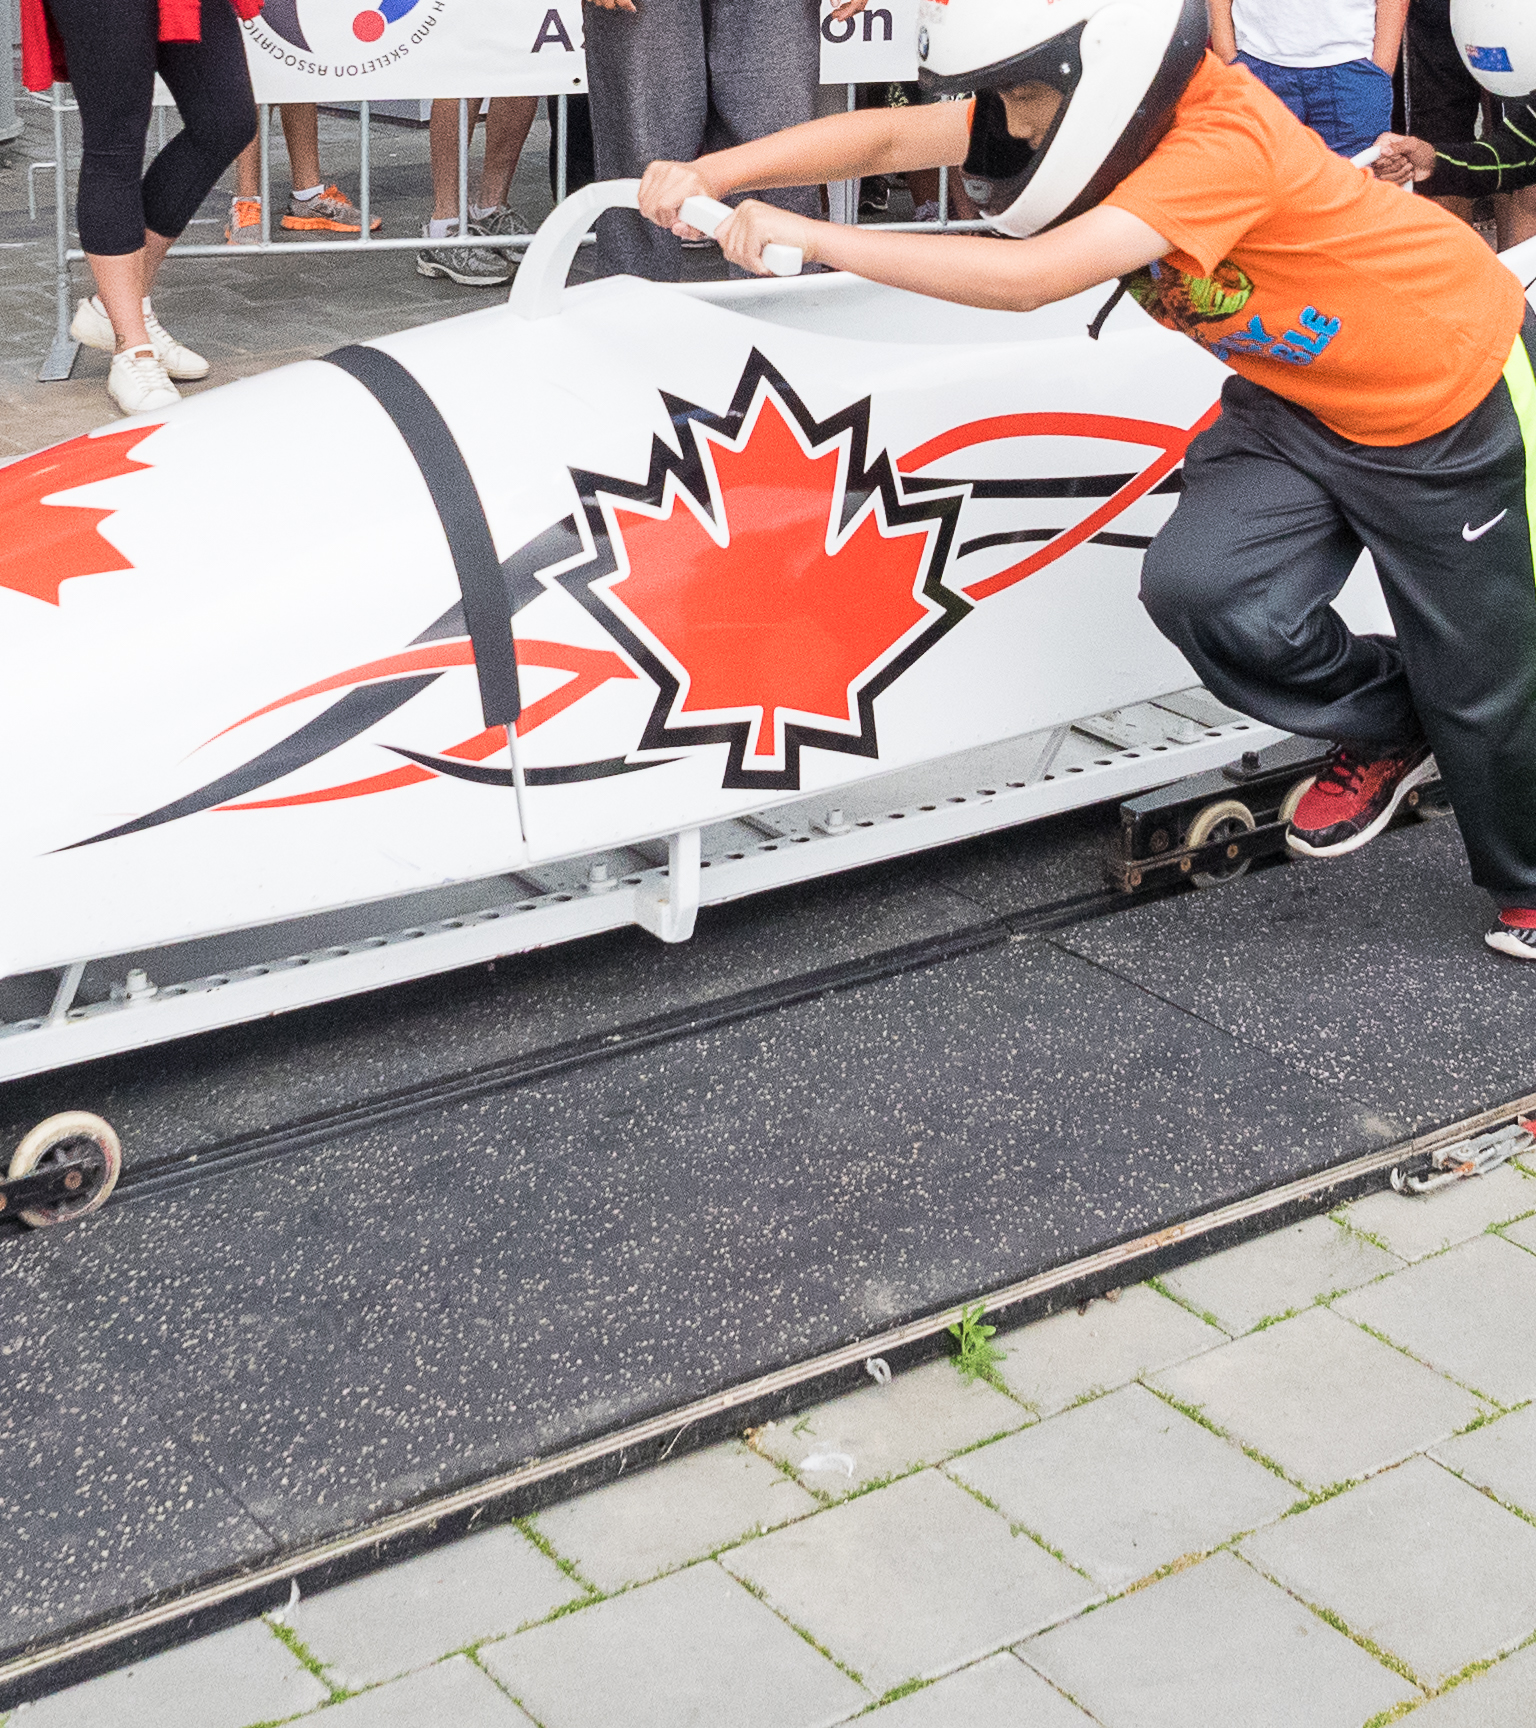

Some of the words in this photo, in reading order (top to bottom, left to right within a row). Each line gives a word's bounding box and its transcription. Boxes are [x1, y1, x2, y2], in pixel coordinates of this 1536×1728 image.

[240, 18, 328, 76] ASSOCIATIO
[410, 15, 437, 45] AND
[335, 43, 409, 78] SKELETON
